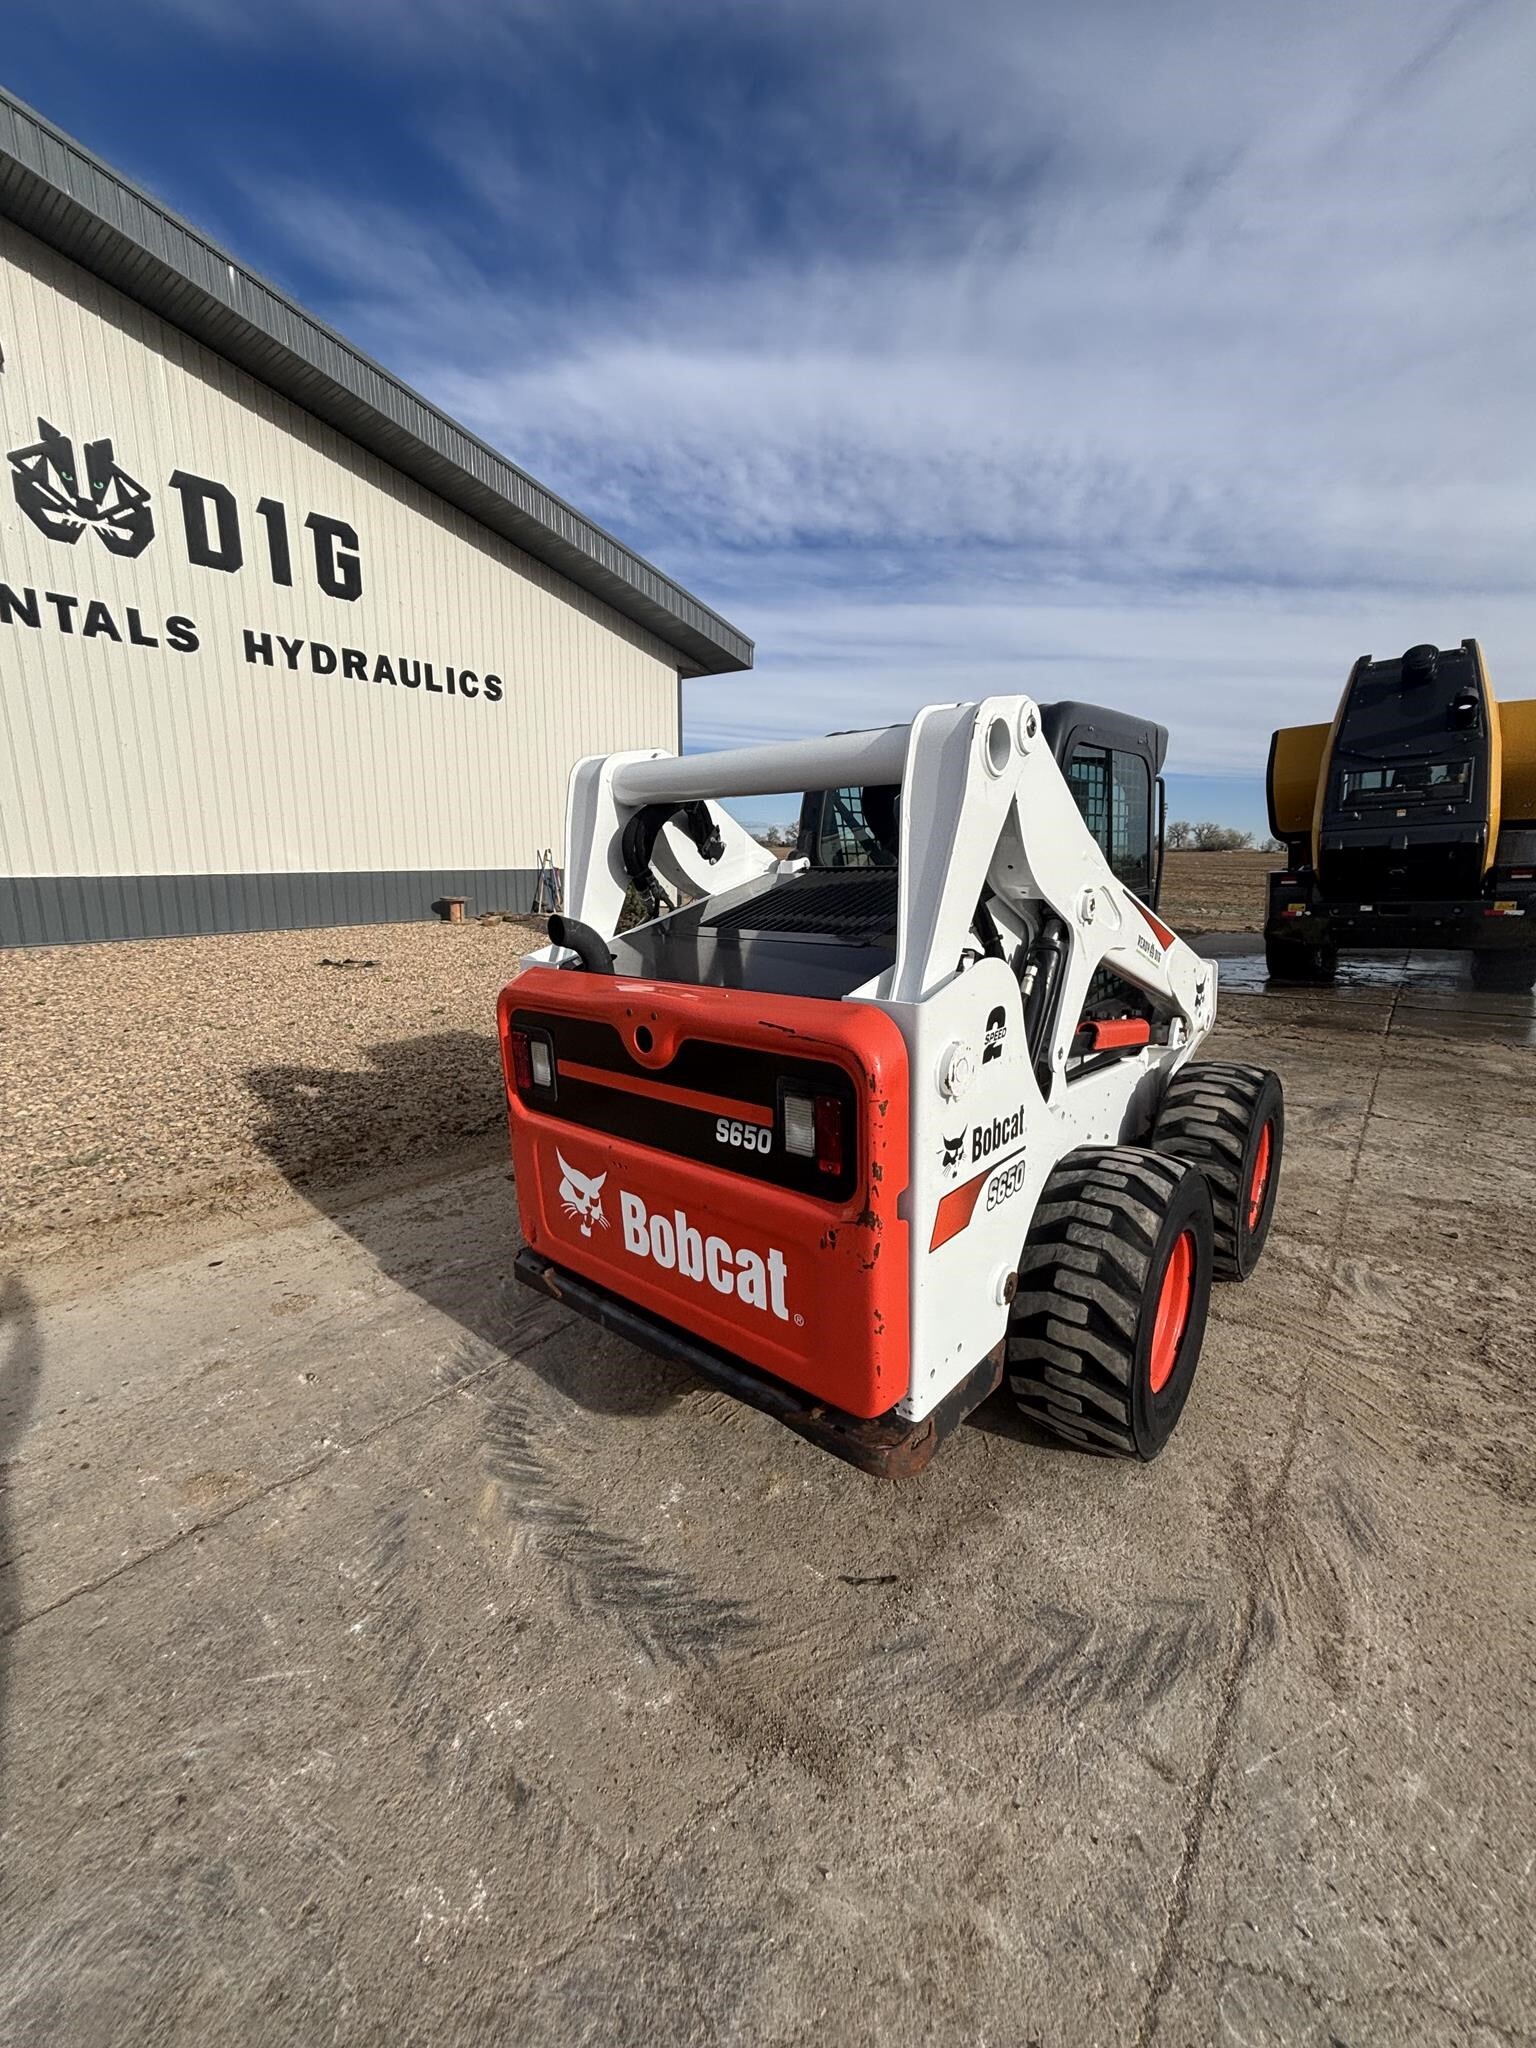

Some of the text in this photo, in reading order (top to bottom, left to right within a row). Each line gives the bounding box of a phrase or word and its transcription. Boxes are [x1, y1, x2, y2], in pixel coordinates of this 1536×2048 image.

[243, 629, 503, 702] HYDRAULICS
[984, 1027, 1007, 1046] SPEED
[715, 1118, 772, 1154] S650
[972, 1104, 1024, 1163] Bobcat
[986, 1159, 1026, 1212] S650
[620, 1189, 789, 1321] Bobcat
